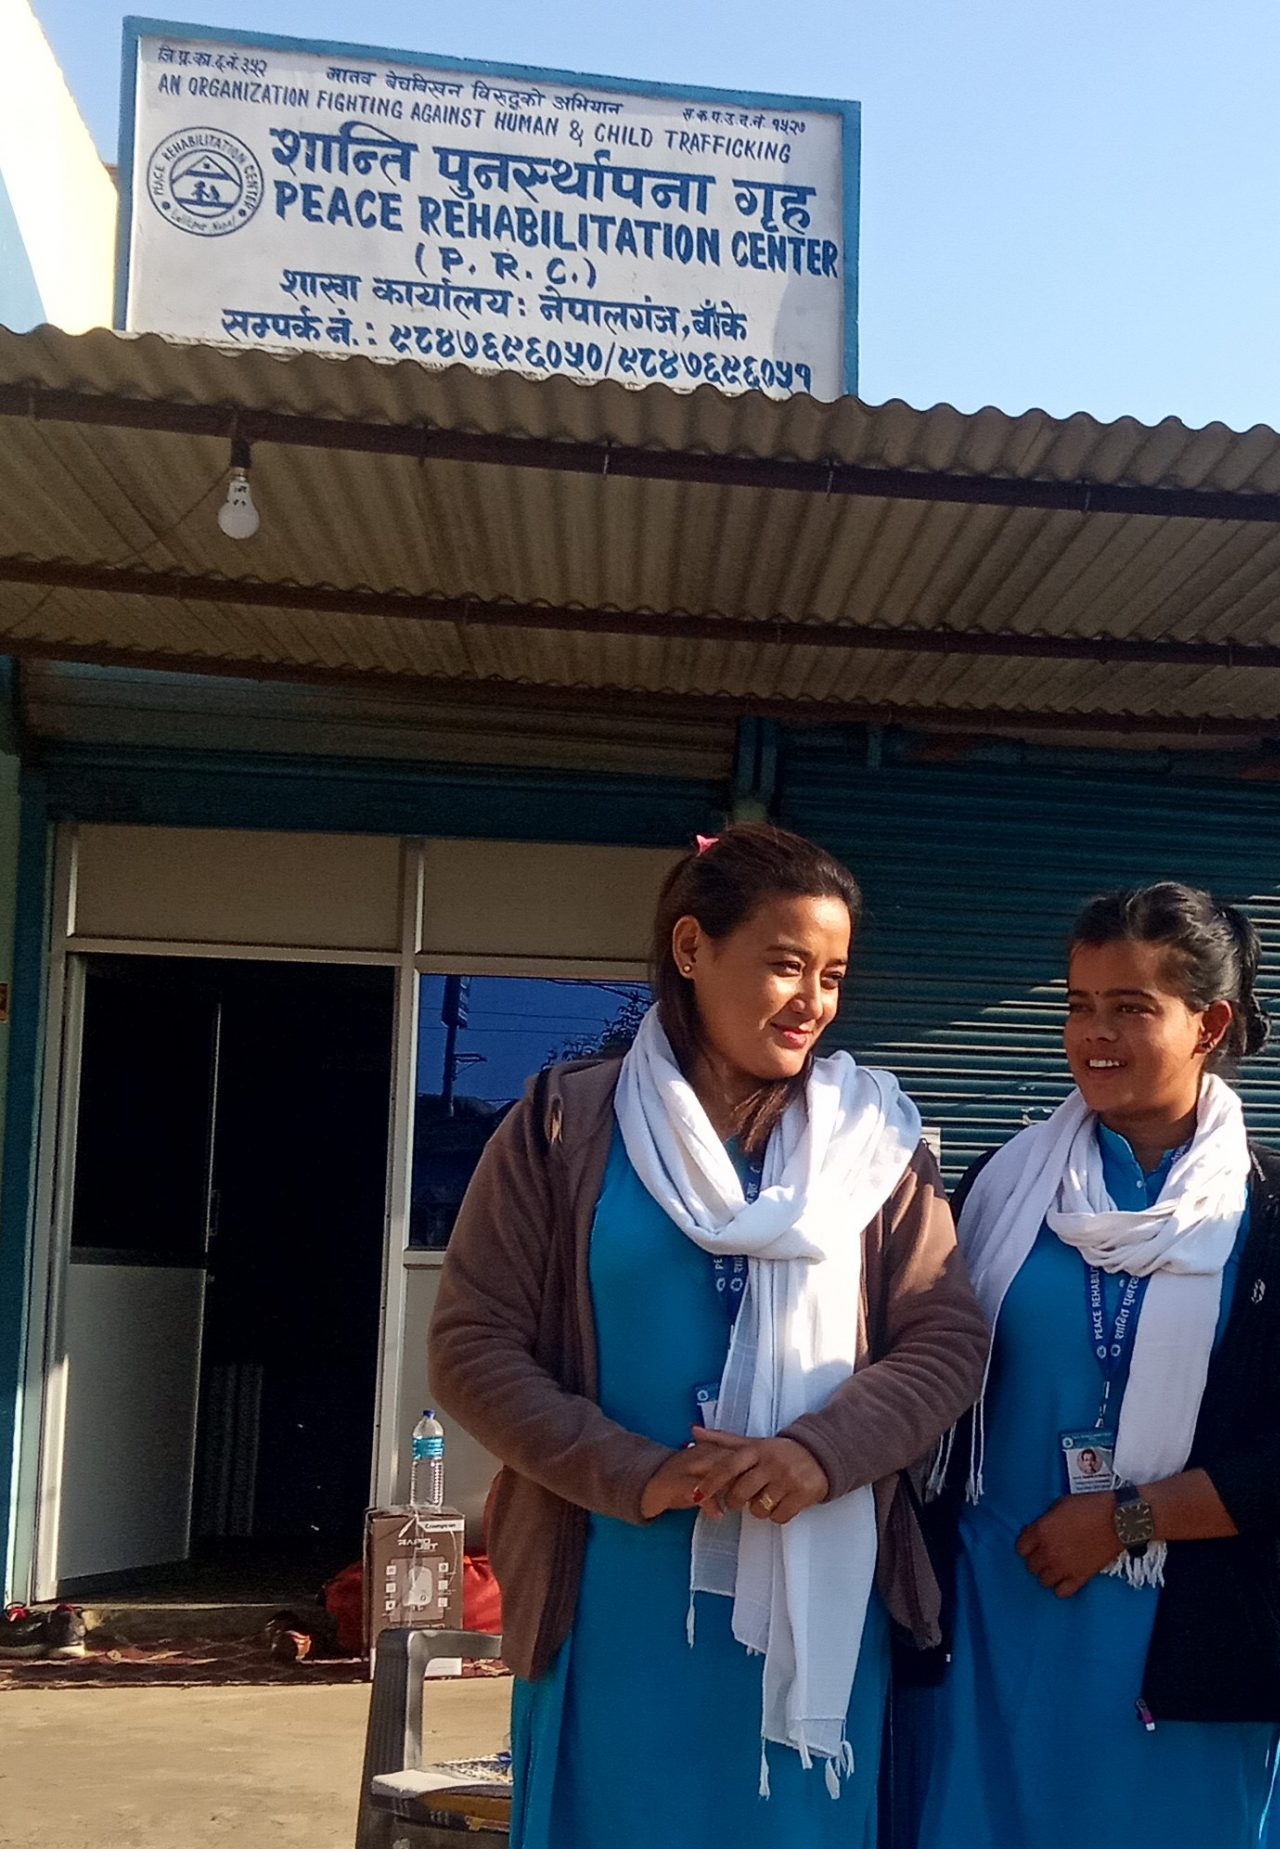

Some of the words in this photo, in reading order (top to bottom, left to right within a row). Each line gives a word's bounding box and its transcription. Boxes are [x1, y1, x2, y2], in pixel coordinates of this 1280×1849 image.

[158, 73, 181, 96] AN
[188, 76, 310, 107] ORGANIZATION
[317, 90, 403, 119] FIGHTING
[410, 101, 485, 129] AGAINST
[494, 111, 559, 136] HUMAN
[569, 119, 584, 147] &
[594, 123, 653, 148] CHILD
[665, 130, 791, 164] TRAFFICKING
[552, 92, 624, 115] अभियान
[269, 120, 419, 185] शान्ति
[732, 178, 816, 234] गृह
[274, 180, 403, 232] PEACE
[418, 195, 721, 267] REHABILITATION
[731, 230, 838, 279] CENTER
[280, 269, 361, 304] शाखा
[1093, 1309, 1104, 1340] PEACE
